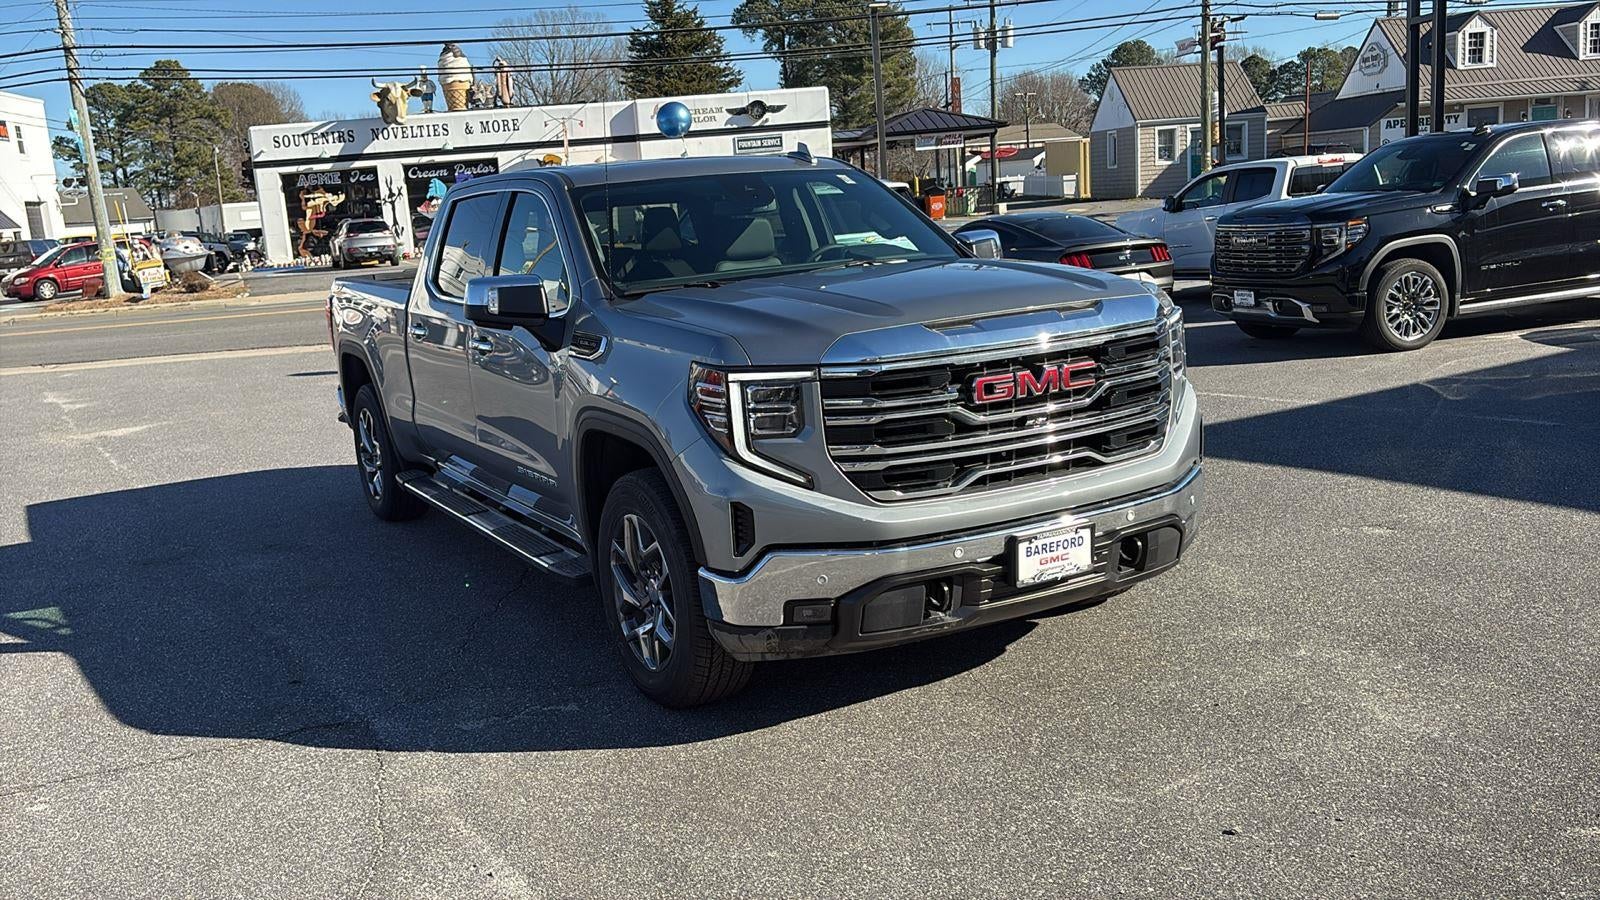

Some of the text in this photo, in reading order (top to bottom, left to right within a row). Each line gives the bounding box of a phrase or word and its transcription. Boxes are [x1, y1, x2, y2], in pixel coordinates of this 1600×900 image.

[1418, 114, 1460, 127] RETY
[272, 118, 520, 149] SOUVENIRS NOVELTIES & MORE
[738, 138, 781, 149] FOUNTAIN SERVICE
[296, 169, 376, 187] ACME Ice
[407, 163, 496, 179] Cream Parlor
[974, 361, 1096, 404] GMC
[1025, 535, 1084, 558] BAREFORD
[1039, 552, 1070, 566] GMC
